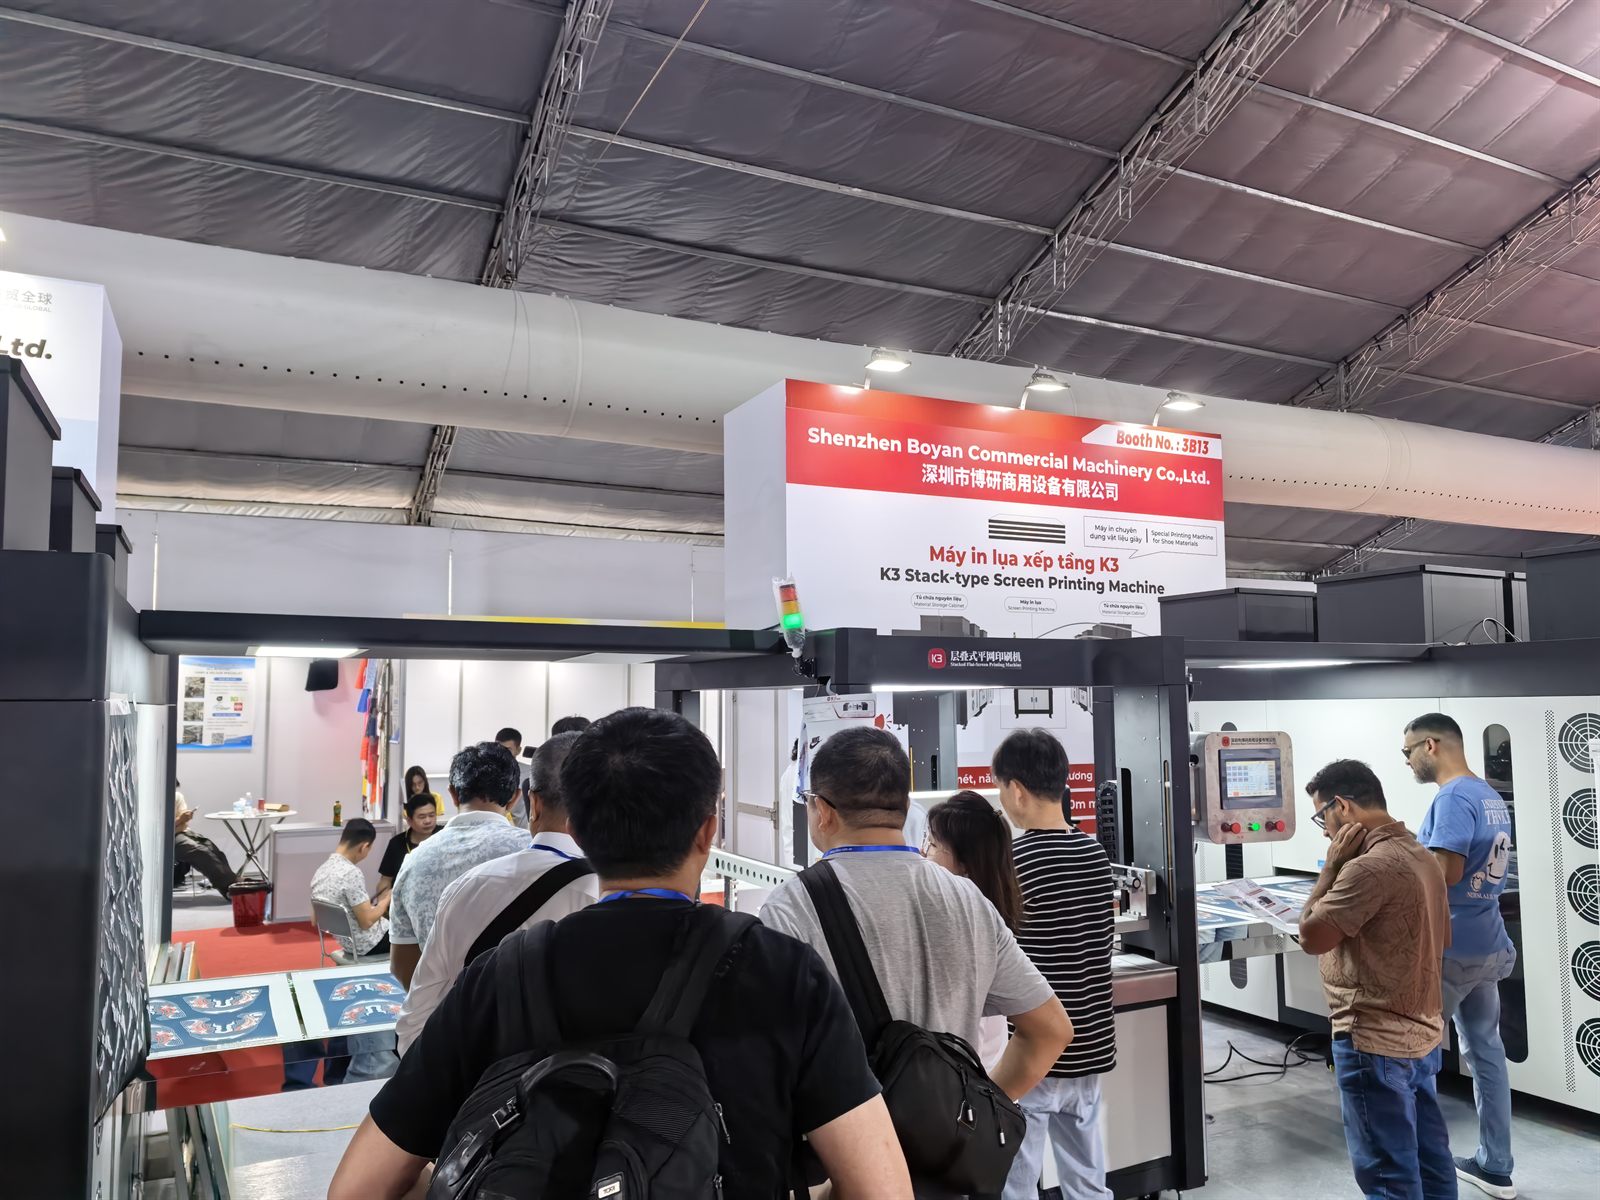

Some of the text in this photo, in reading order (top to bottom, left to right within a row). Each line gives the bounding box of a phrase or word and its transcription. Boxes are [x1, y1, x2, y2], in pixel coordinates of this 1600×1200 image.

[1117, 430, 1152, 447] Booth
[1182, 438, 1209, 454] 3B13
[808, 427, 1210, 485] Shenzhen Boyan Commercial Machinery Co.,Ltd.
[922, 463, 1118, 501] 深圳市博研商用设备有限公司
[1170, 532, 1191, 540] Printing
[930, 545, 1119, 574] Máy in lụa xếp tầng K3
[880, 567, 1165, 594] K3 Stack-type Screen Printing Machine
[931, 654, 943, 663] K3
[950, 650, 1021, 662] 层叠式平网印刷机
[1066, 771, 1093, 782] ương
